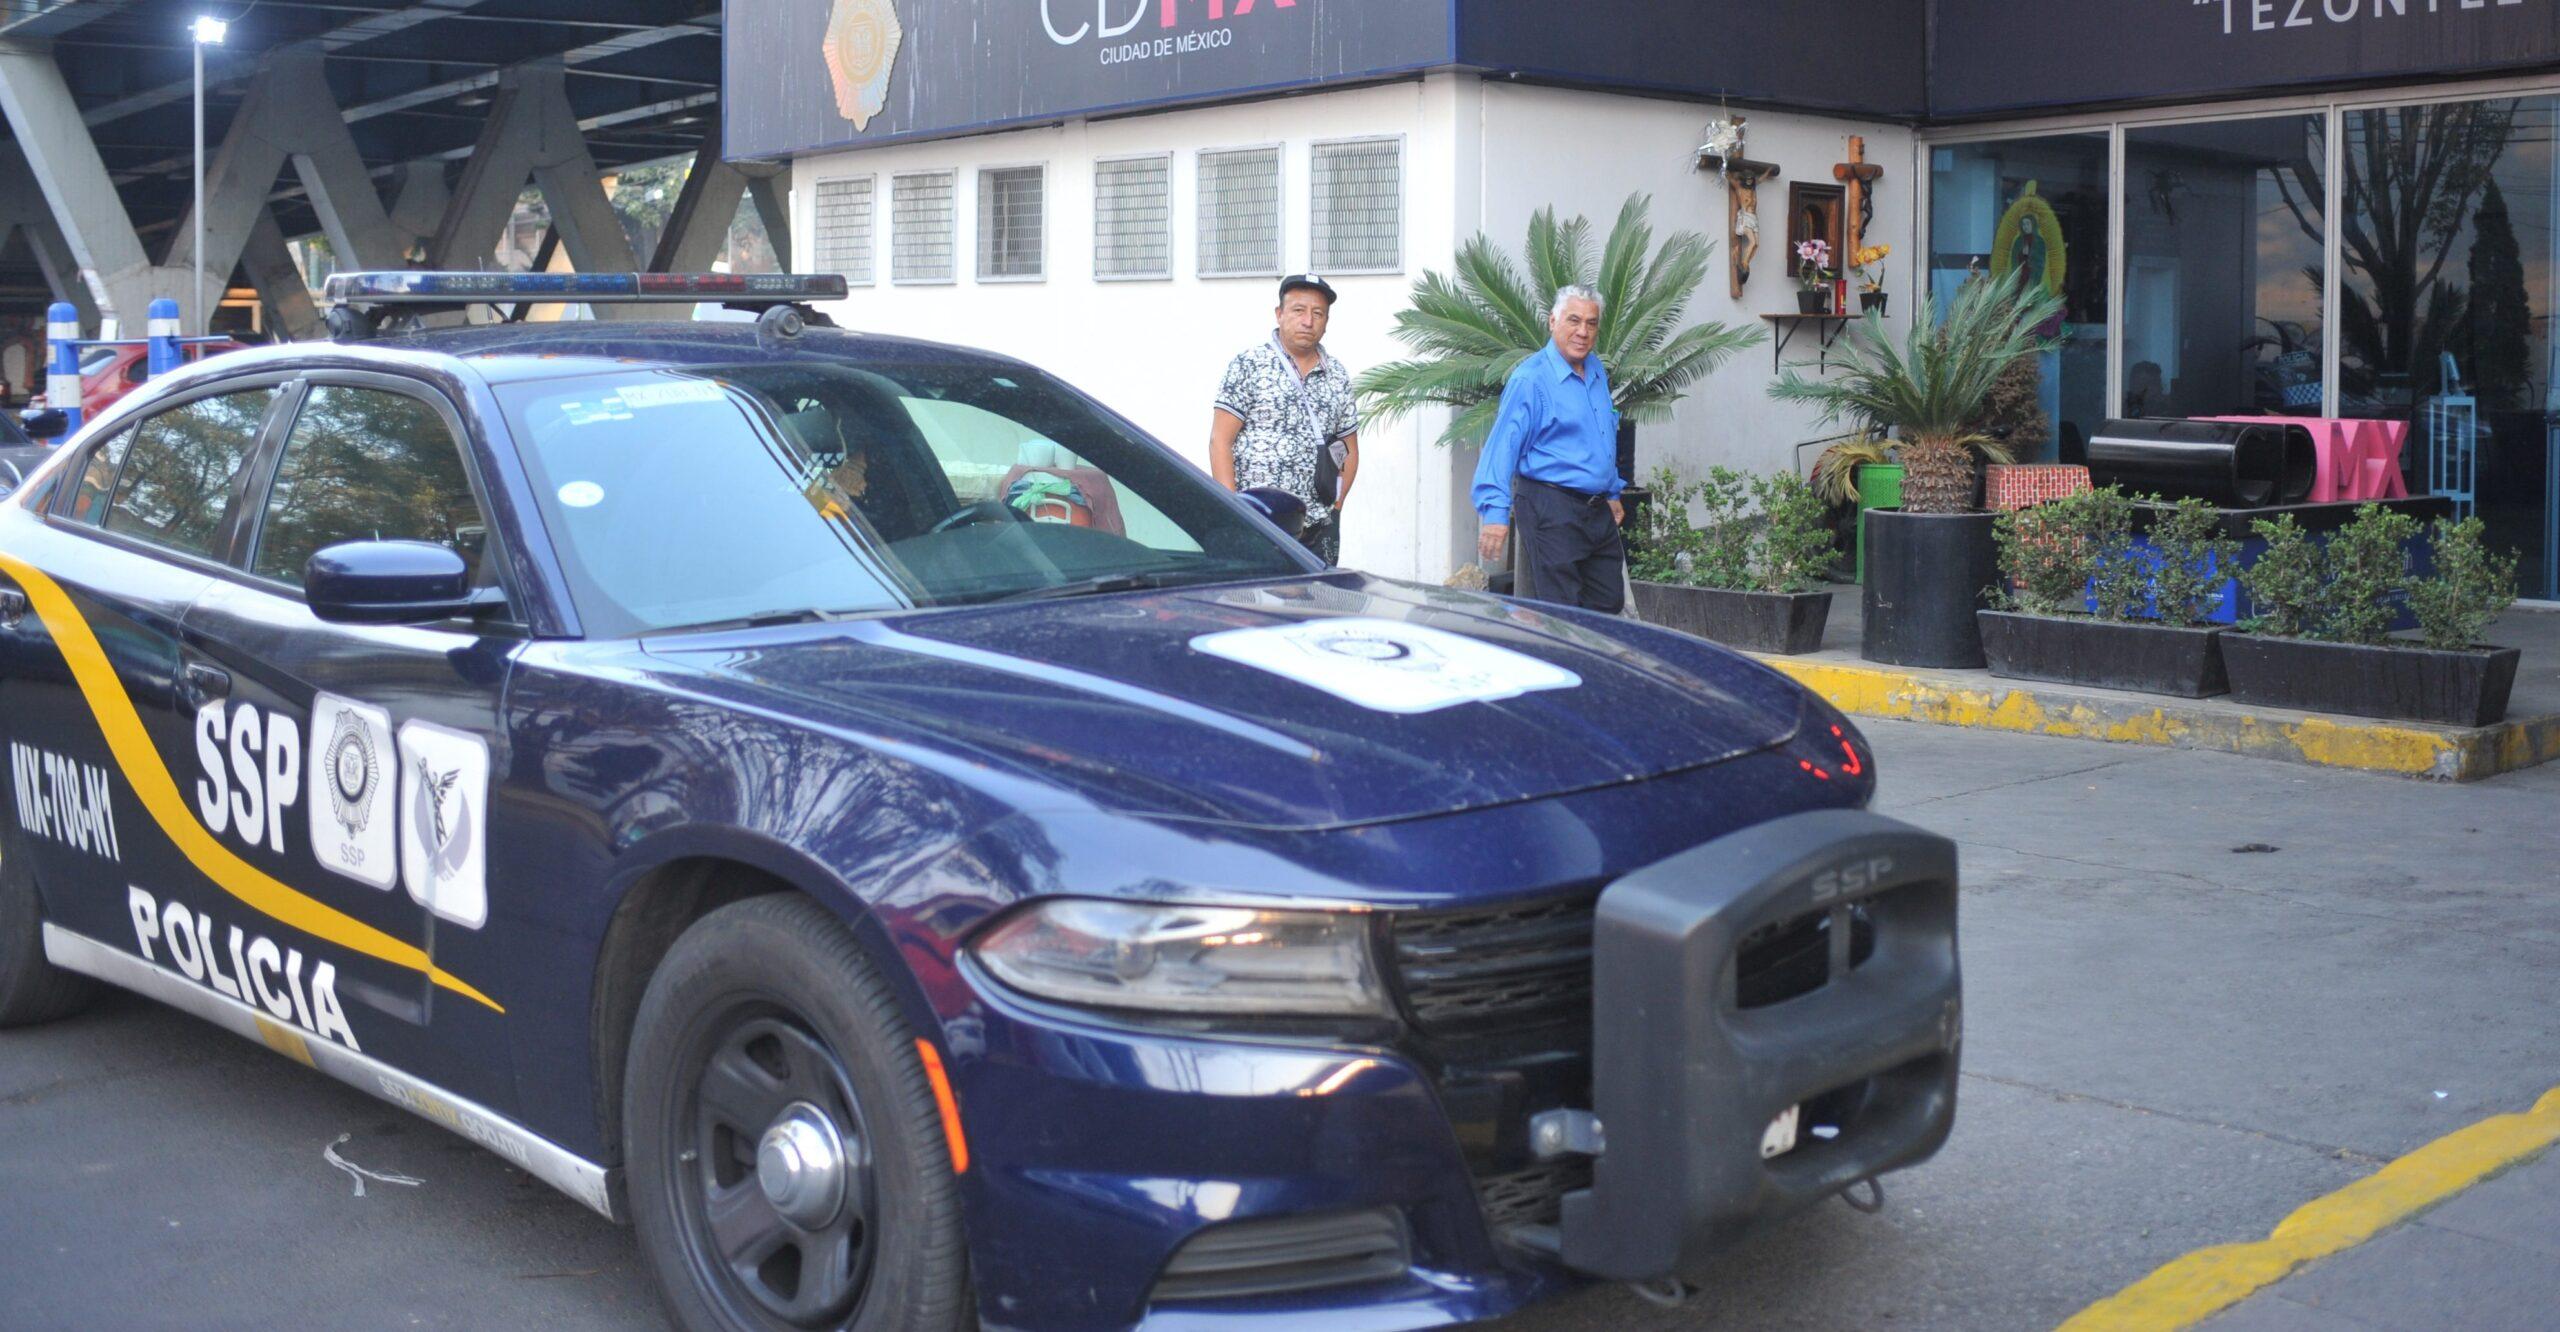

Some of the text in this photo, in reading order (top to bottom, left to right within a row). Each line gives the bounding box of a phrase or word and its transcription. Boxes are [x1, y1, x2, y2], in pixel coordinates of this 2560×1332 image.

[1100, 28, 1232, 65] CIUDAD DE MÉXICO
[11, 741, 120, 862] MX-708-N1
[196, 698, 300, 854] SSP
[340, 842, 365, 868] SSP
[1812, 857, 1893, 901] SSP
[128, 884, 362, 1053] POLICIA
